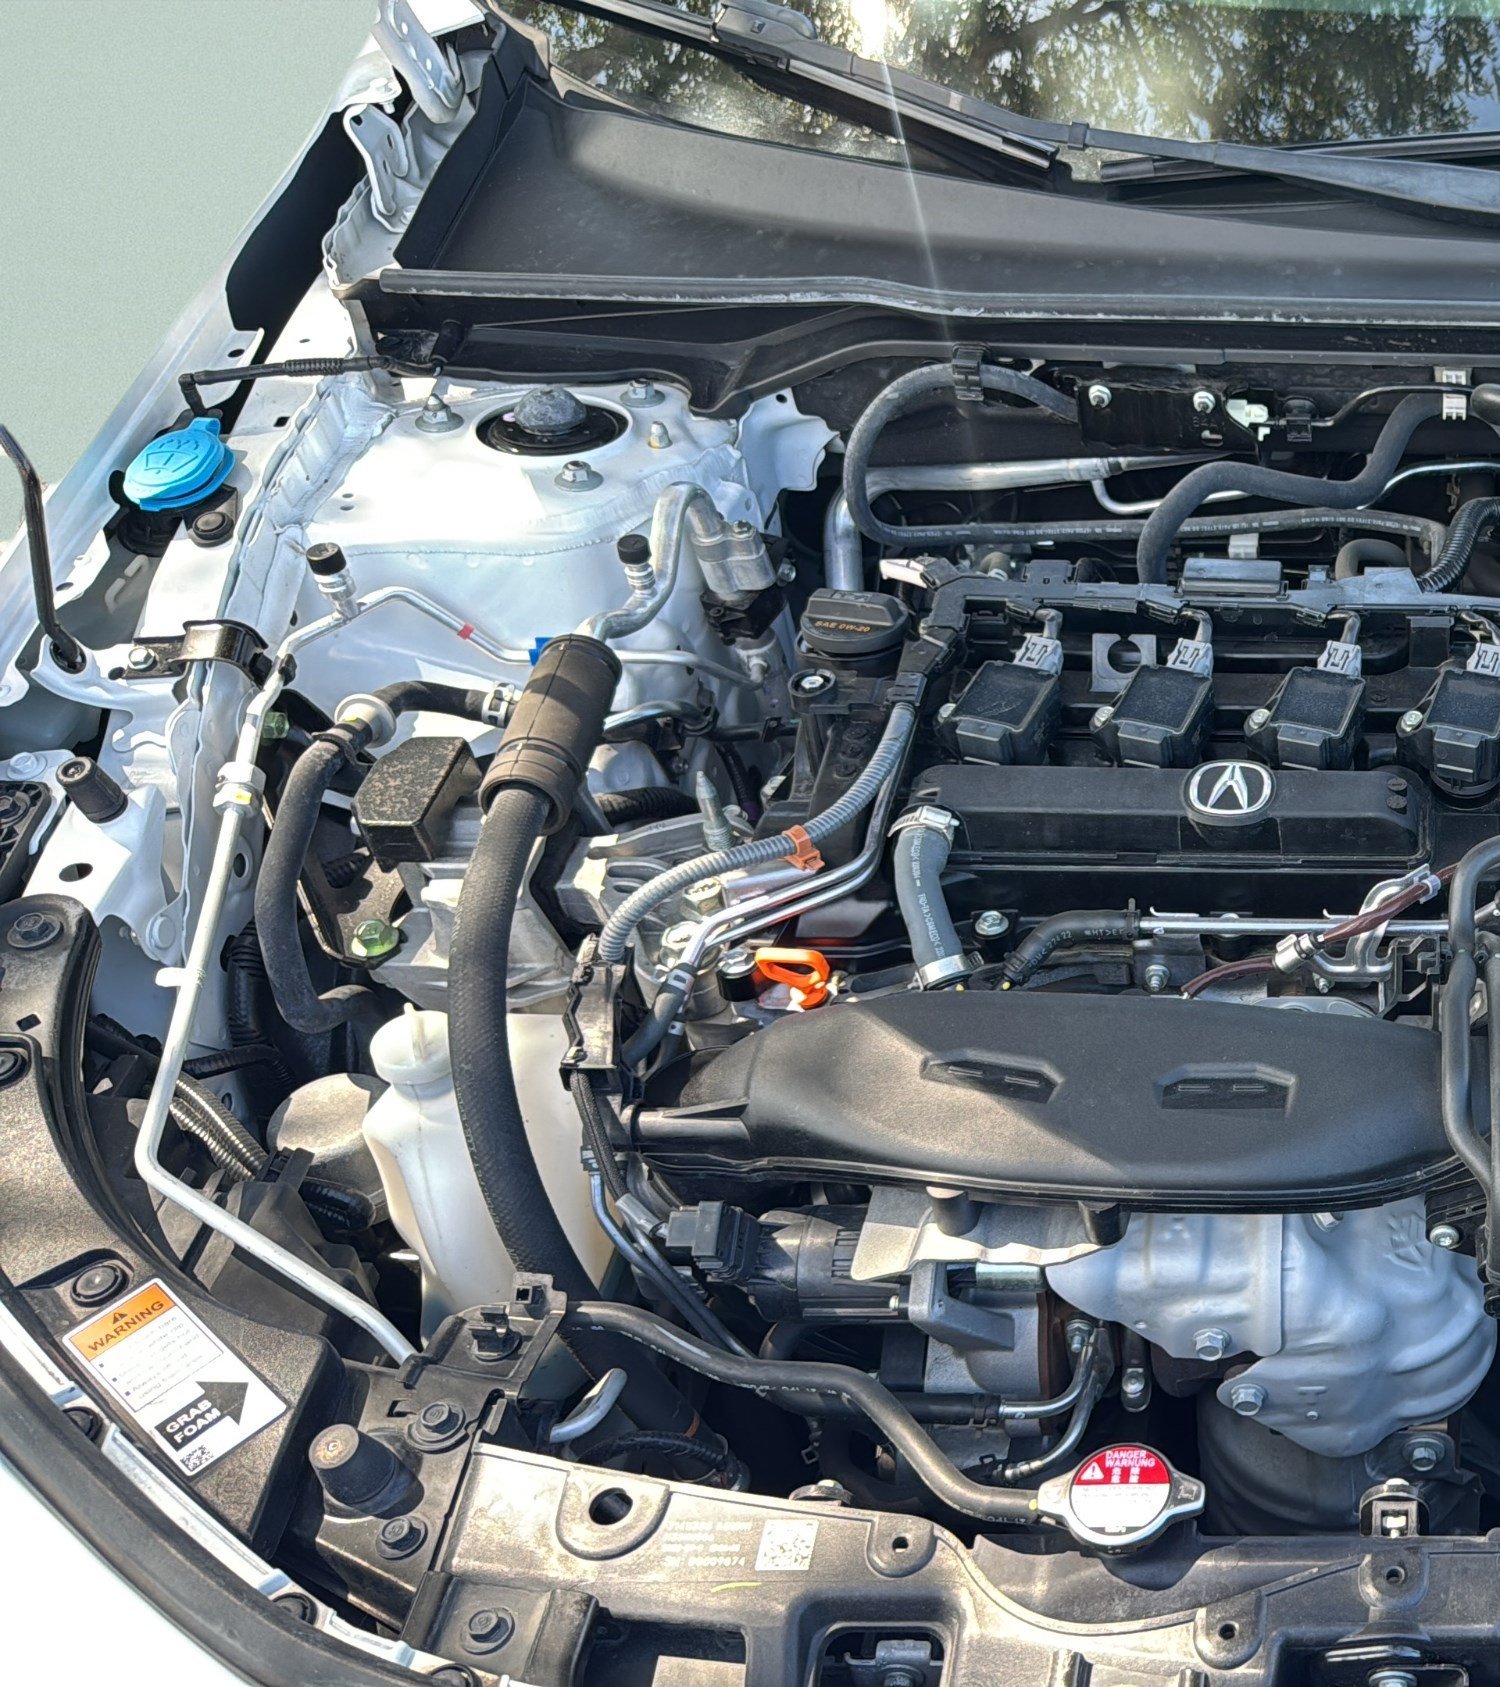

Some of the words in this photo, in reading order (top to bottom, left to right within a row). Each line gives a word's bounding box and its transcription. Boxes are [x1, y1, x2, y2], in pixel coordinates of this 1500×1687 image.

[814, 620, 837, 629] SAE
[88, 1300, 165, 1352] WARNING
[165, 1399, 213, 1433] GRAB
[173, 1407, 222, 1444] FOAM
[1105, 1450, 1147, 1459] DANGER
[1105, 1457, 1156, 1468] WARNUNG
